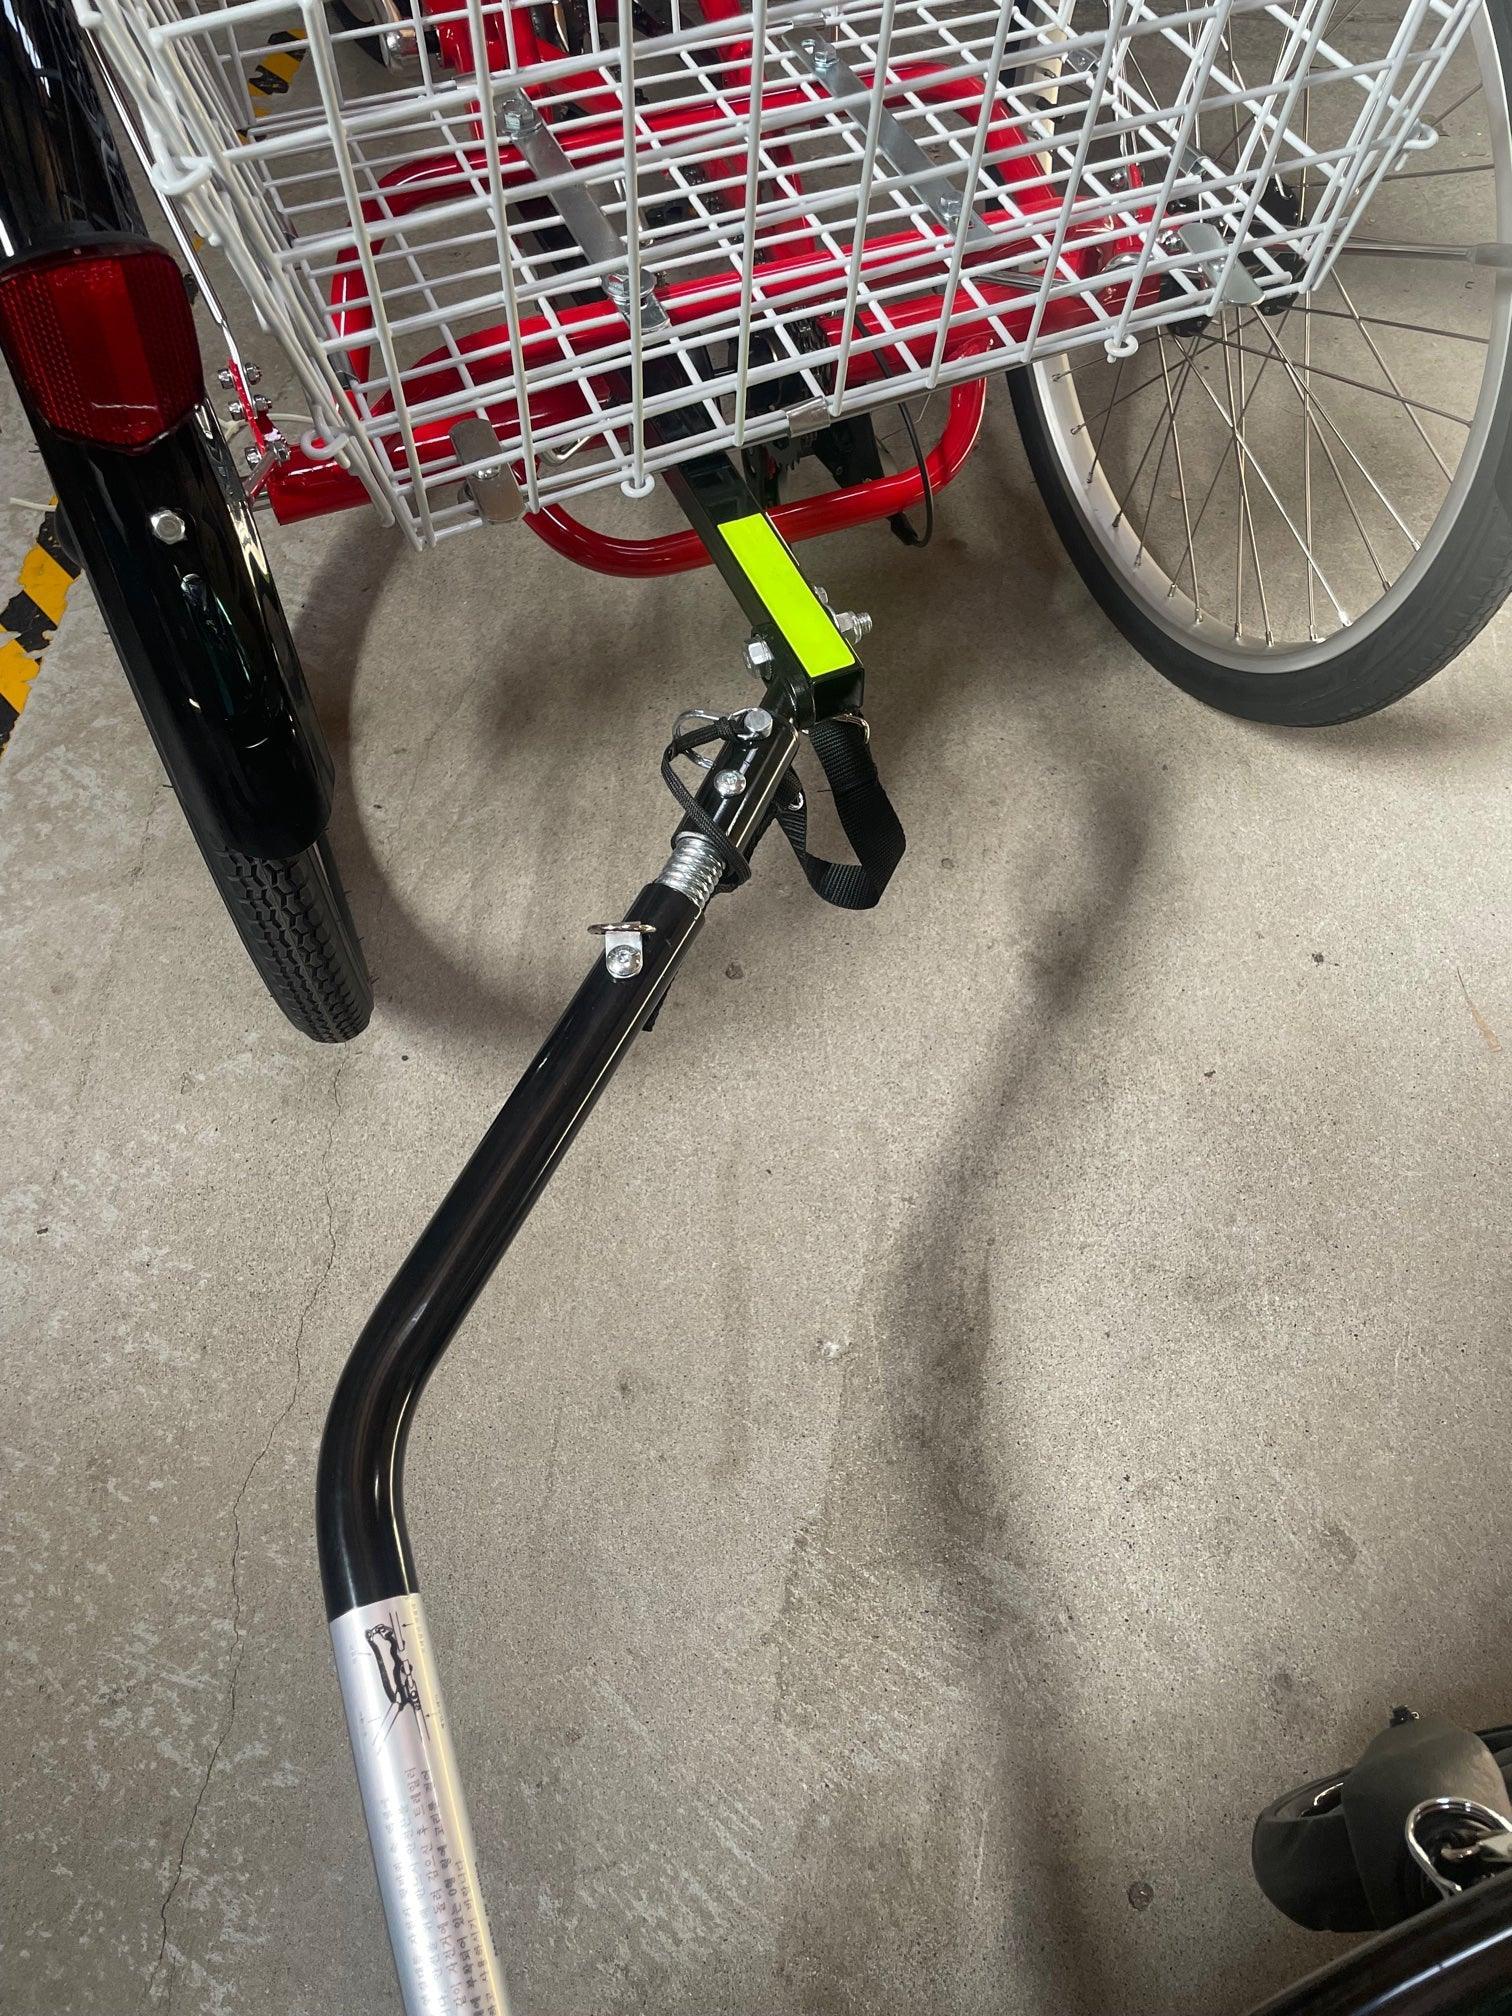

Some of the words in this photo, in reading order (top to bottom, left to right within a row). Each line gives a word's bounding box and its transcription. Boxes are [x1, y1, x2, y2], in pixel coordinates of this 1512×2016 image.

[403, 1765, 426, 1818] 트레일러
[419, 1840, 439, 1881] 감으신
[448, 1901, 465, 1929] 있는
[435, 1920, 459, 1974] 자전거에
